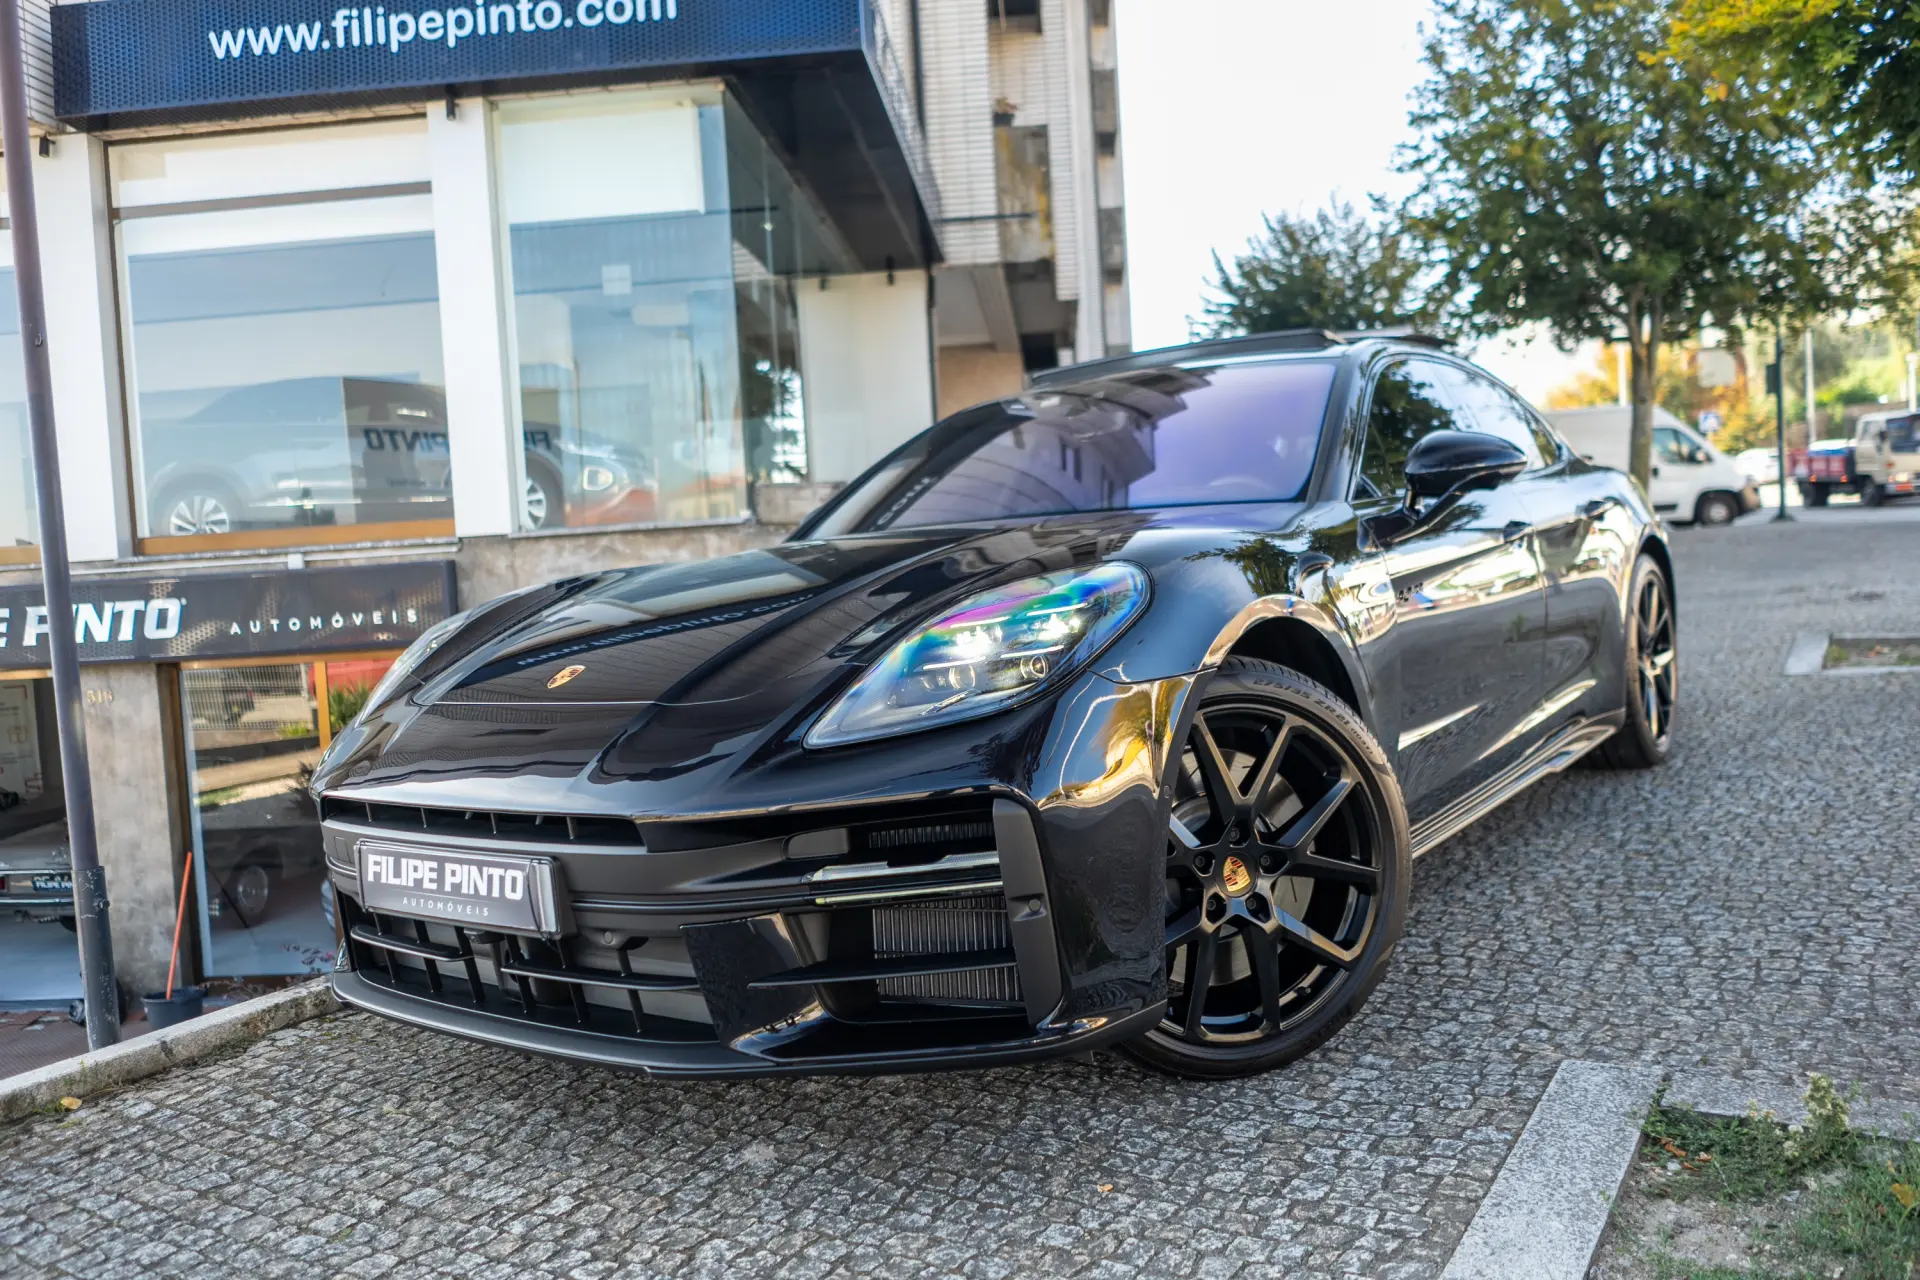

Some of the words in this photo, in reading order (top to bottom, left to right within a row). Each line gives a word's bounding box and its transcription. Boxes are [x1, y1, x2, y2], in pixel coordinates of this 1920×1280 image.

[209, 0, 678, 60] www.filipepinto.com
[23, 598, 182, 646] PNTO
[230, 607, 417, 636] AUTOMÓVEIS
[368, 854, 438, 890] FILIPE
[444, 862, 524, 901] PINTO
[402, 896, 490, 917] AUTOMÓVEIS
